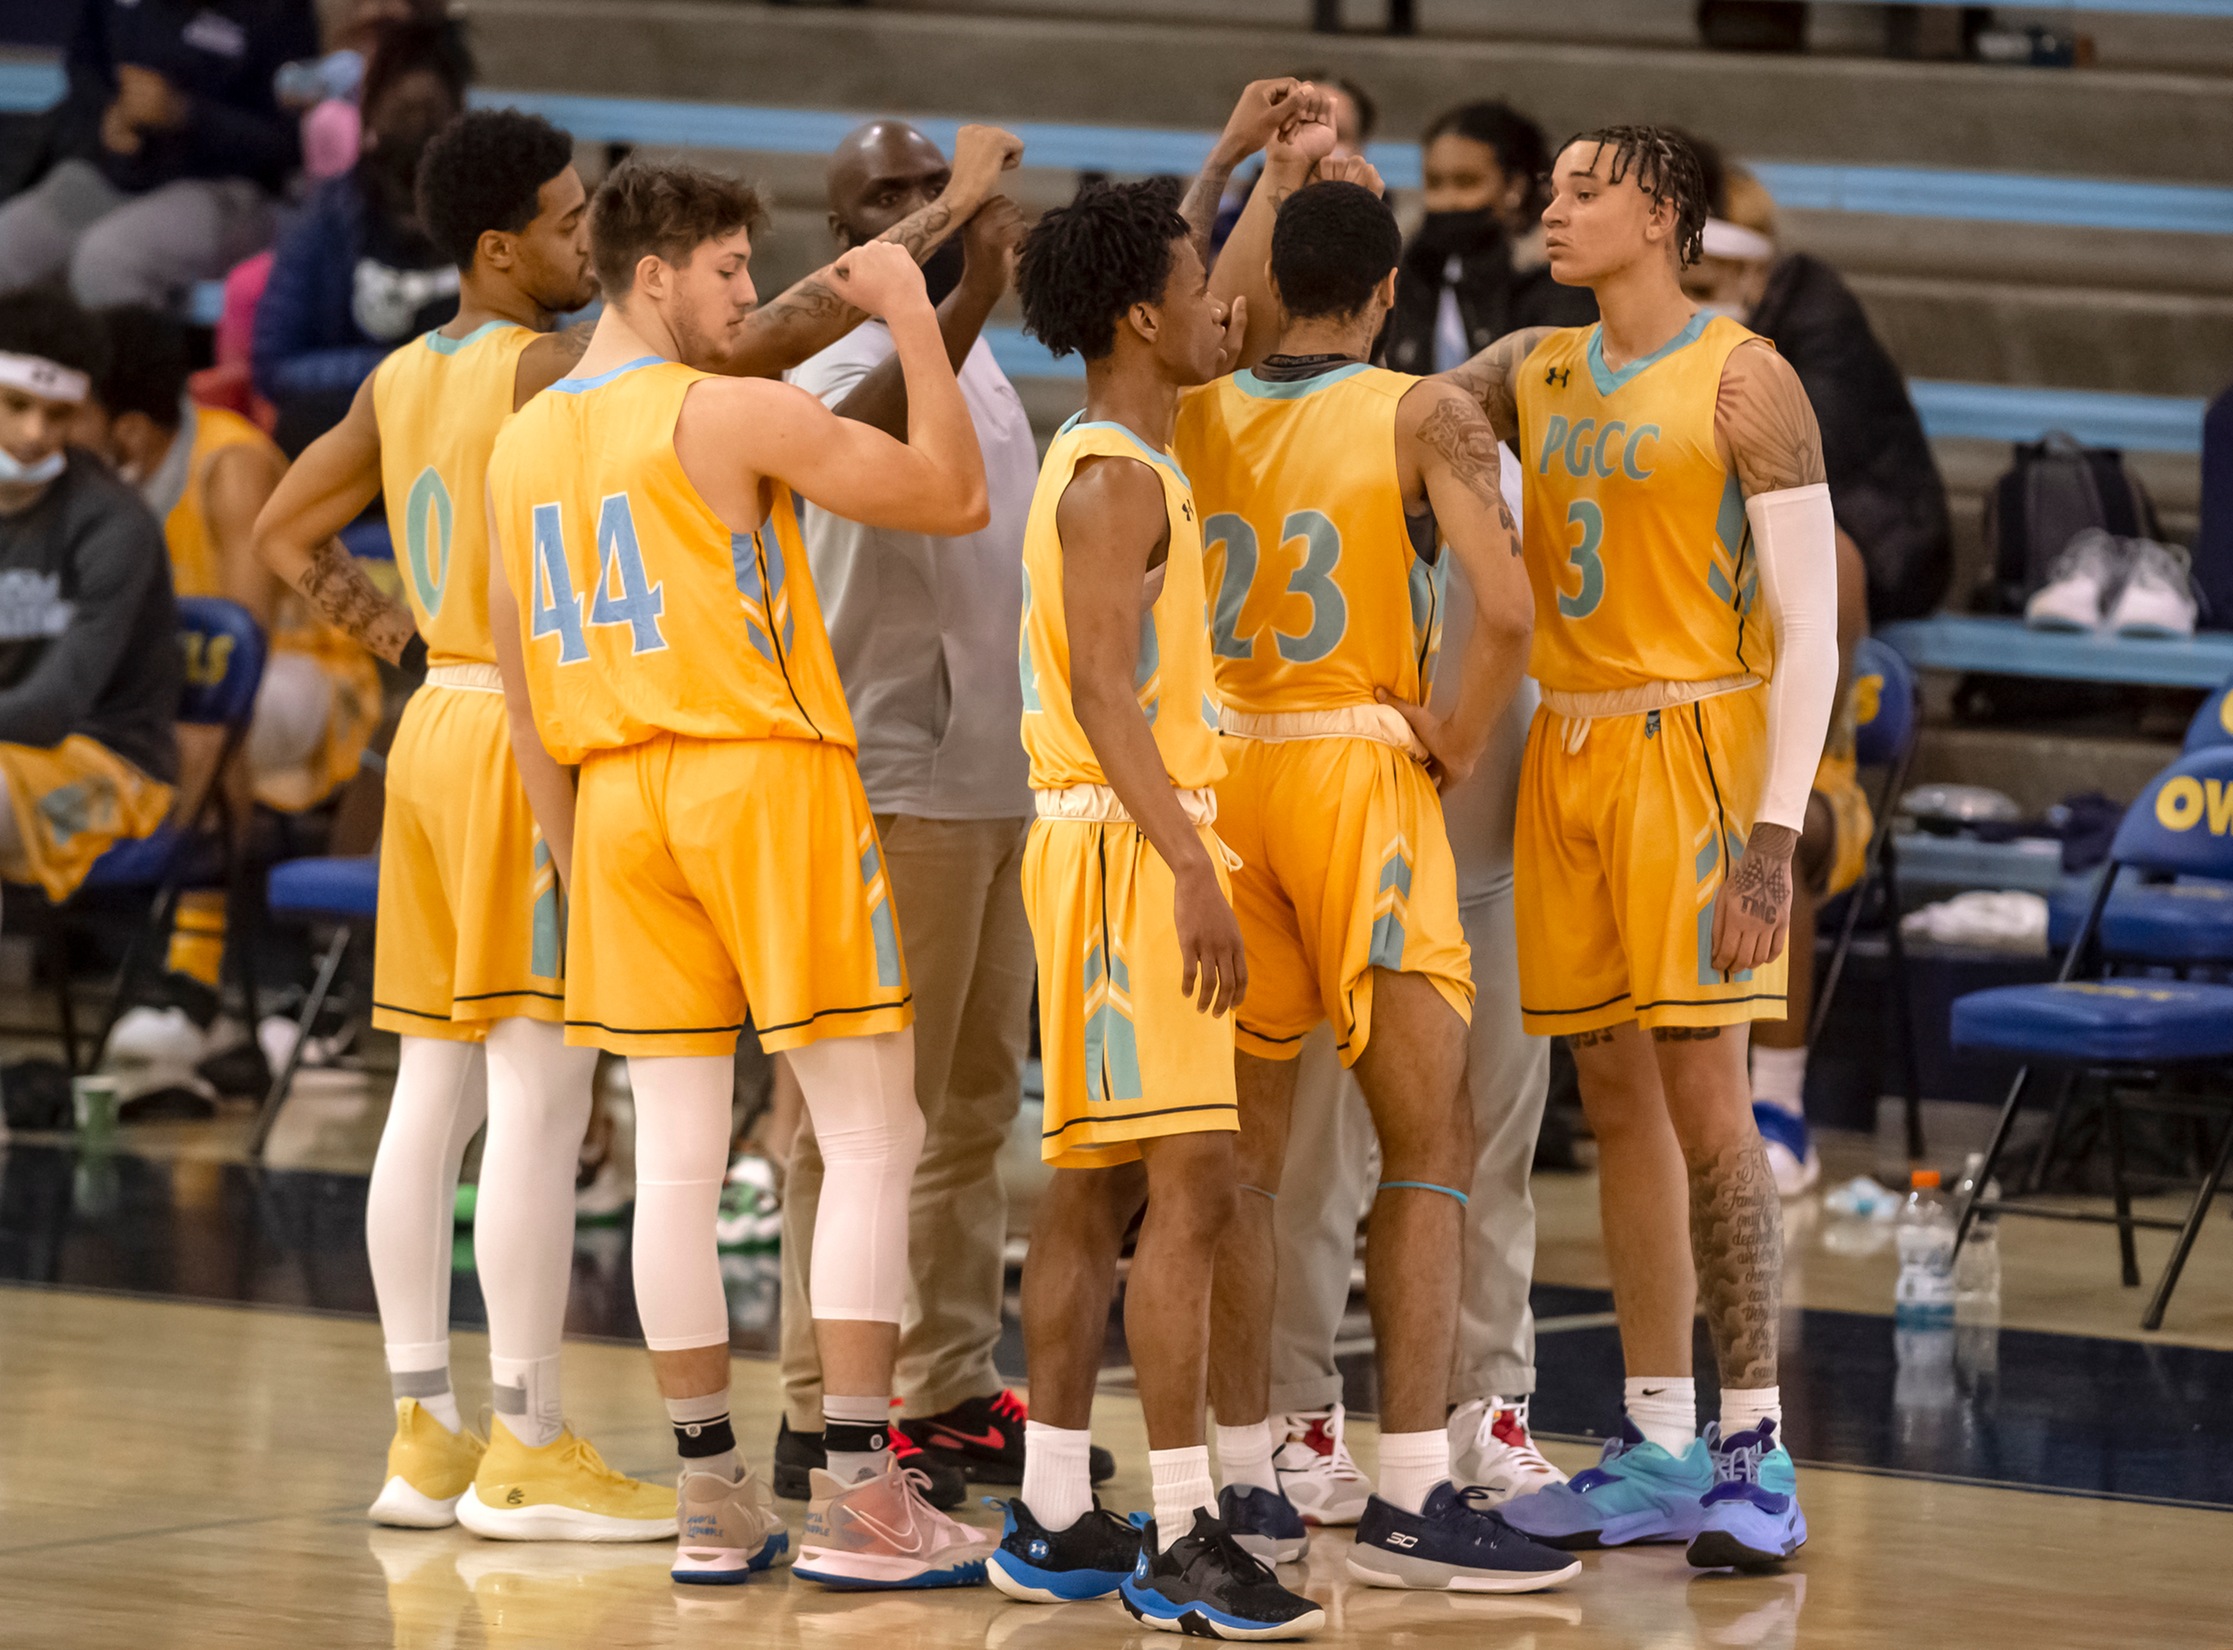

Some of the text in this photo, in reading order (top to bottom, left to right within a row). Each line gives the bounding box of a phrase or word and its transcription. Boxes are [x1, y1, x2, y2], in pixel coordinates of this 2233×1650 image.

[1538, 412, 1662, 481] PGCC
[405, 464, 454, 621] 0
[531, 491, 669, 667] 44
[1203, 509, 1349, 665] 23
[1556, 498, 1606, 620] 3
[1741, 894, 1777, 925] TMC
